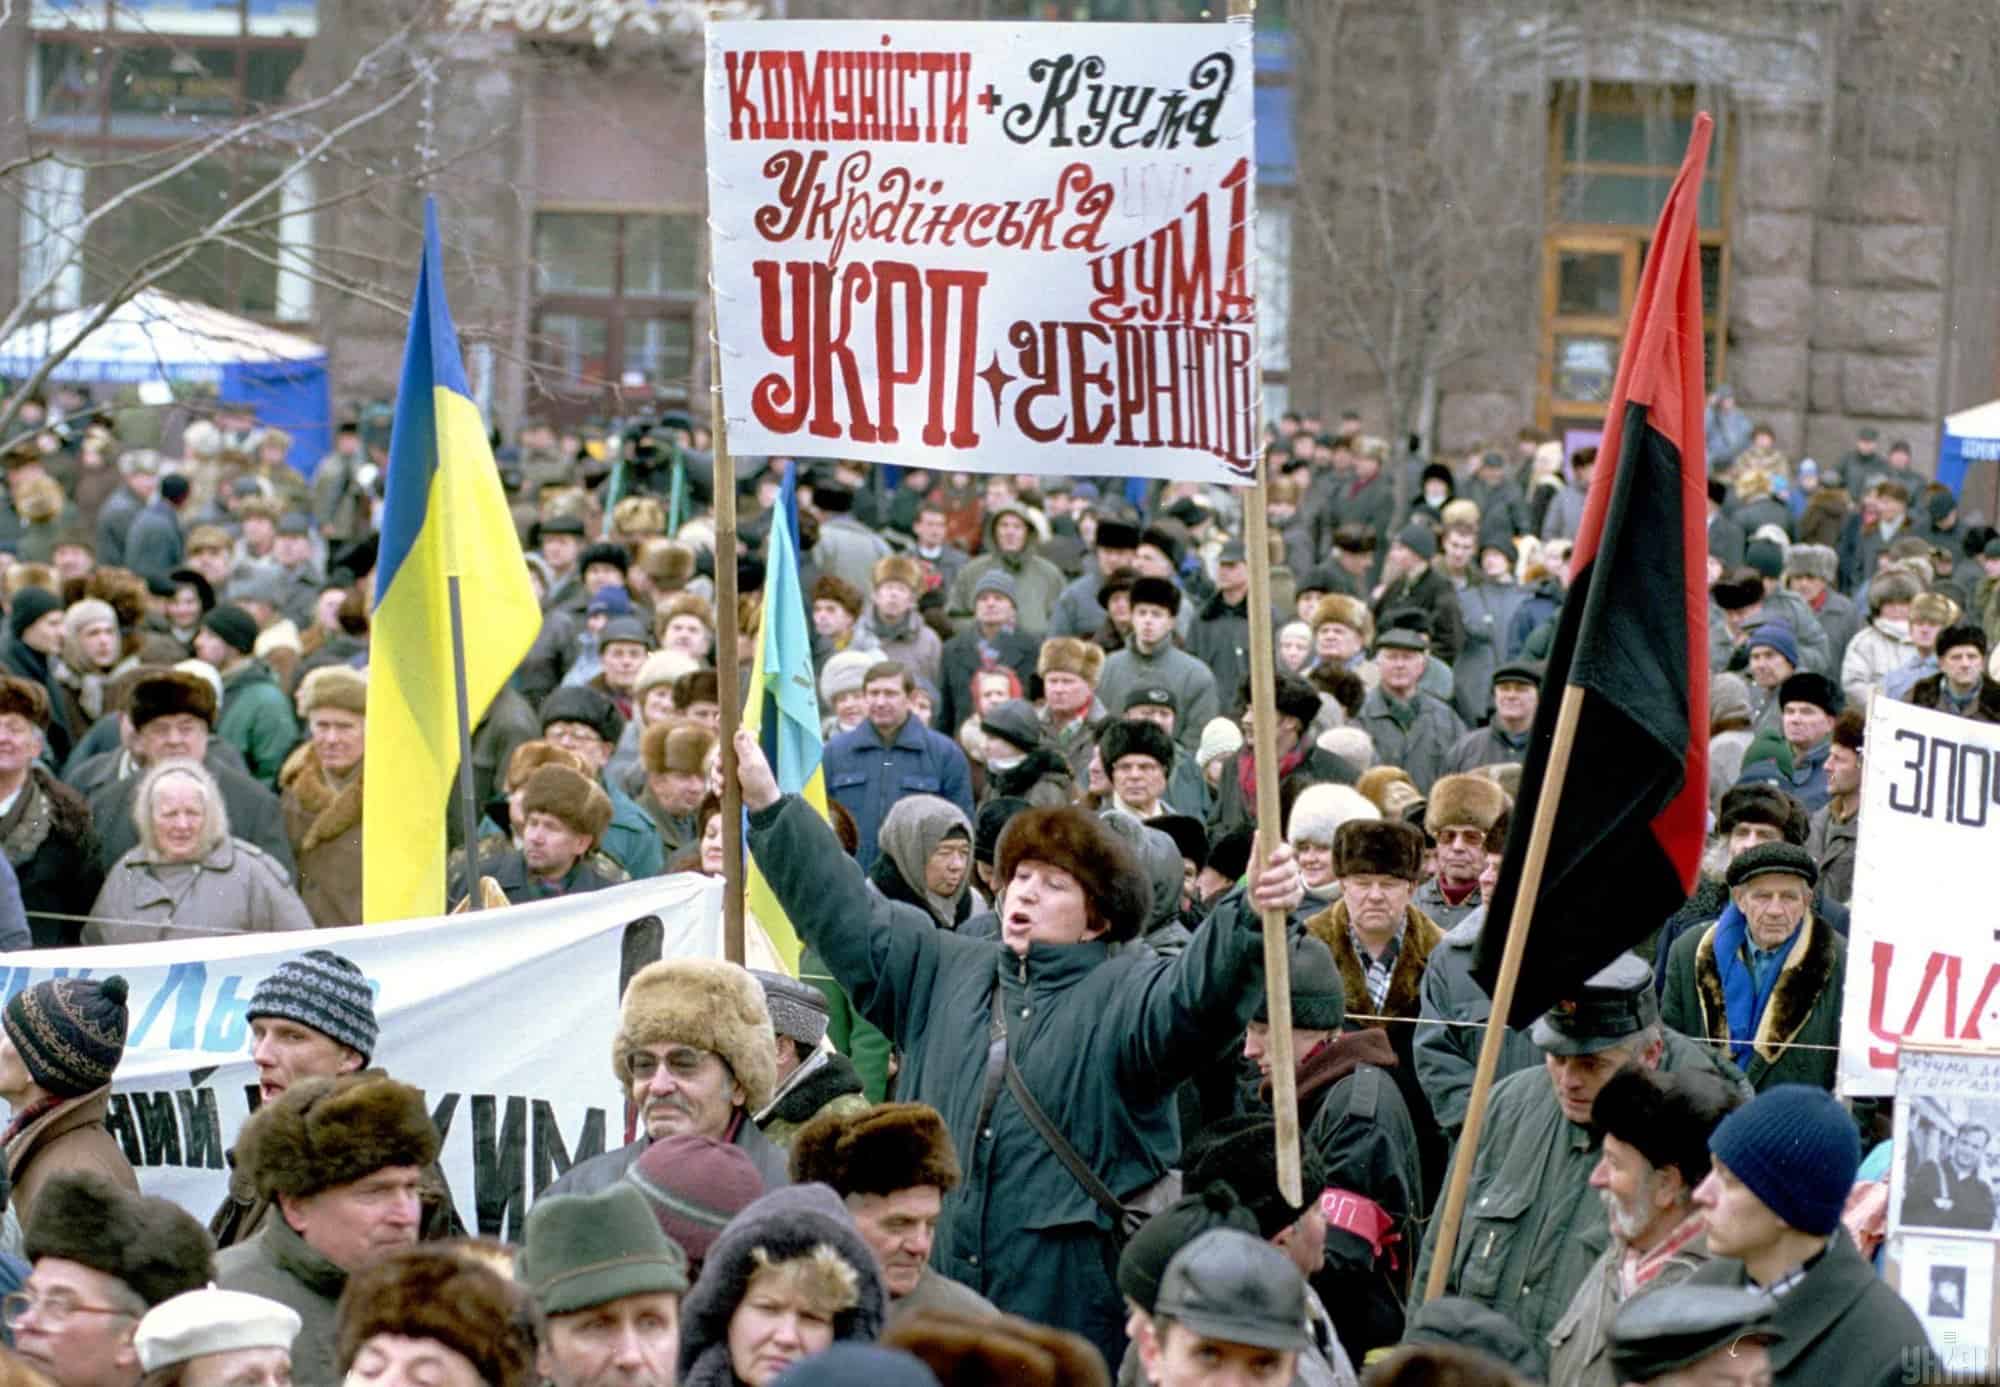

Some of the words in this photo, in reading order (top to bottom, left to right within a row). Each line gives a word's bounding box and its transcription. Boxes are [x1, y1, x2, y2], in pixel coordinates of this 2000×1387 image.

[724, 34, 971, 144] КОМУНІСТИ
[754, 150, 1114, 270] Українська
[752, 260, 988, 448] УКРП
[105, 1065, 225, 1169] НИЙ
